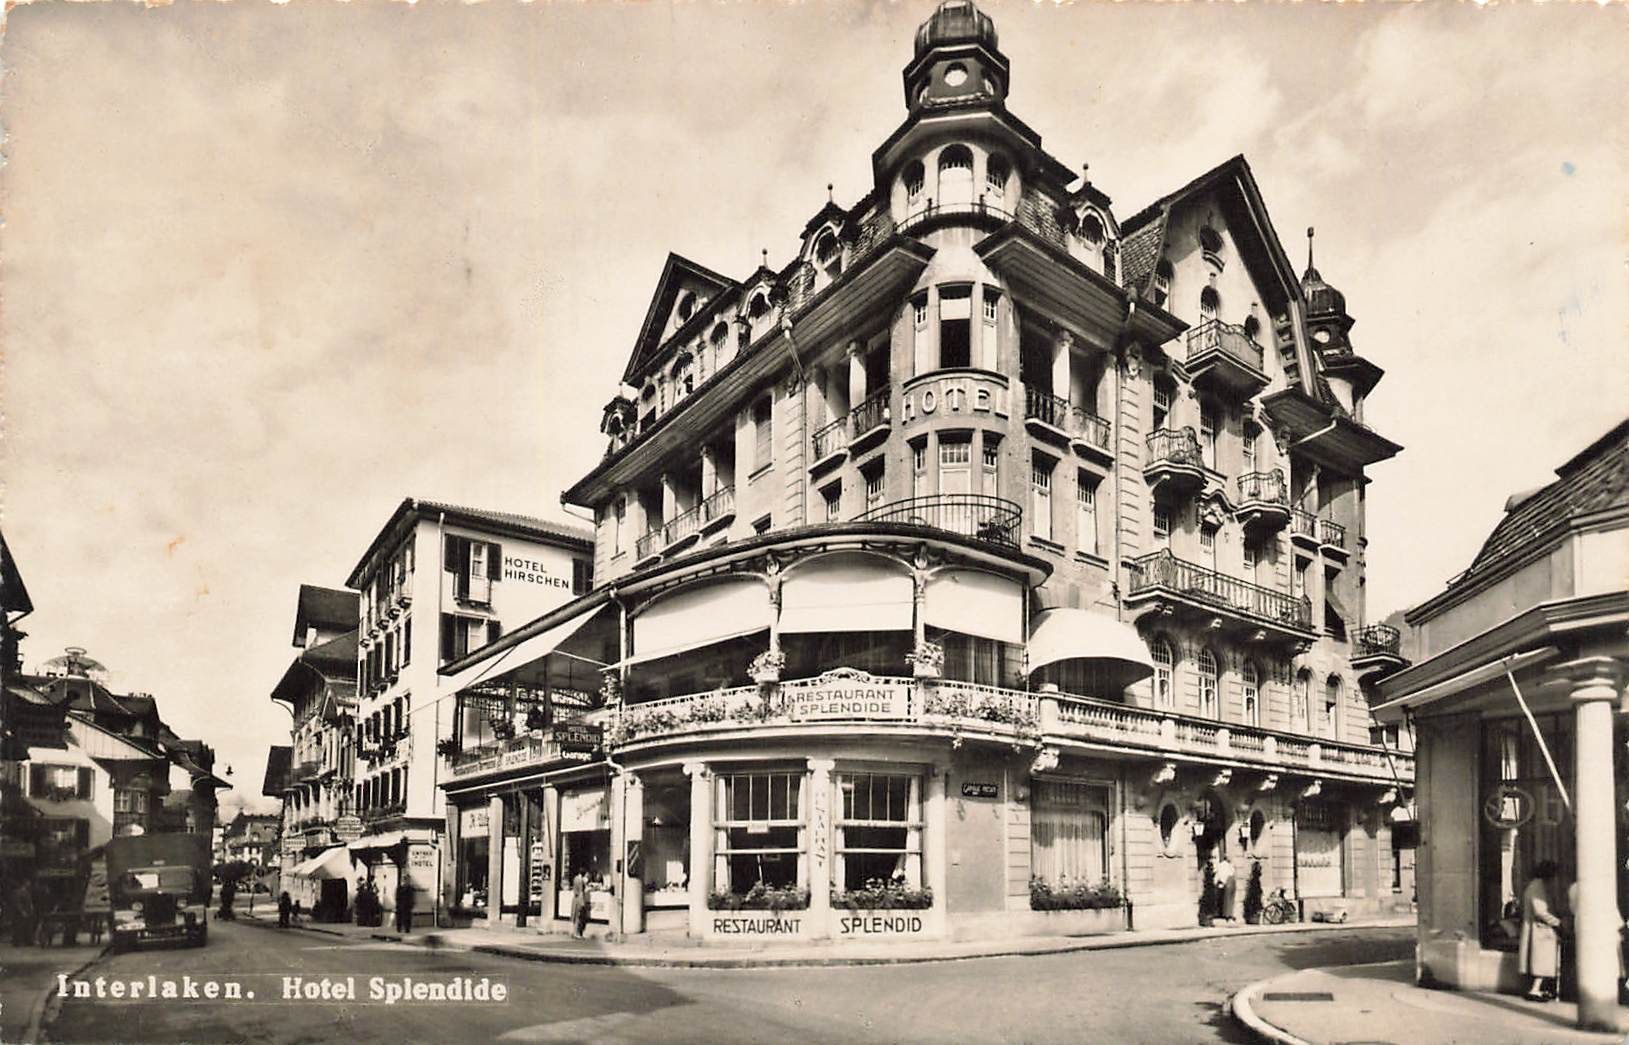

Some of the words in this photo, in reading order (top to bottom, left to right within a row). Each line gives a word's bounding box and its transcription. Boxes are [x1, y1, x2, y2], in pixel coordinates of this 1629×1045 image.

[902, 386, 1009, 426] HOTEL
[504, 557, 547, 574] HOTEL
[504, 568, 570, 589] HIRSCHEN
[796, 689, 895, 703] RESTAURANT
[799, 703, 892, 716] SPLENDIDE
[561, 750, 592, 762] Garage
[713, 918, 801, 934] RESTAURANT
[840, 917, 922, 934] SPLENDID
